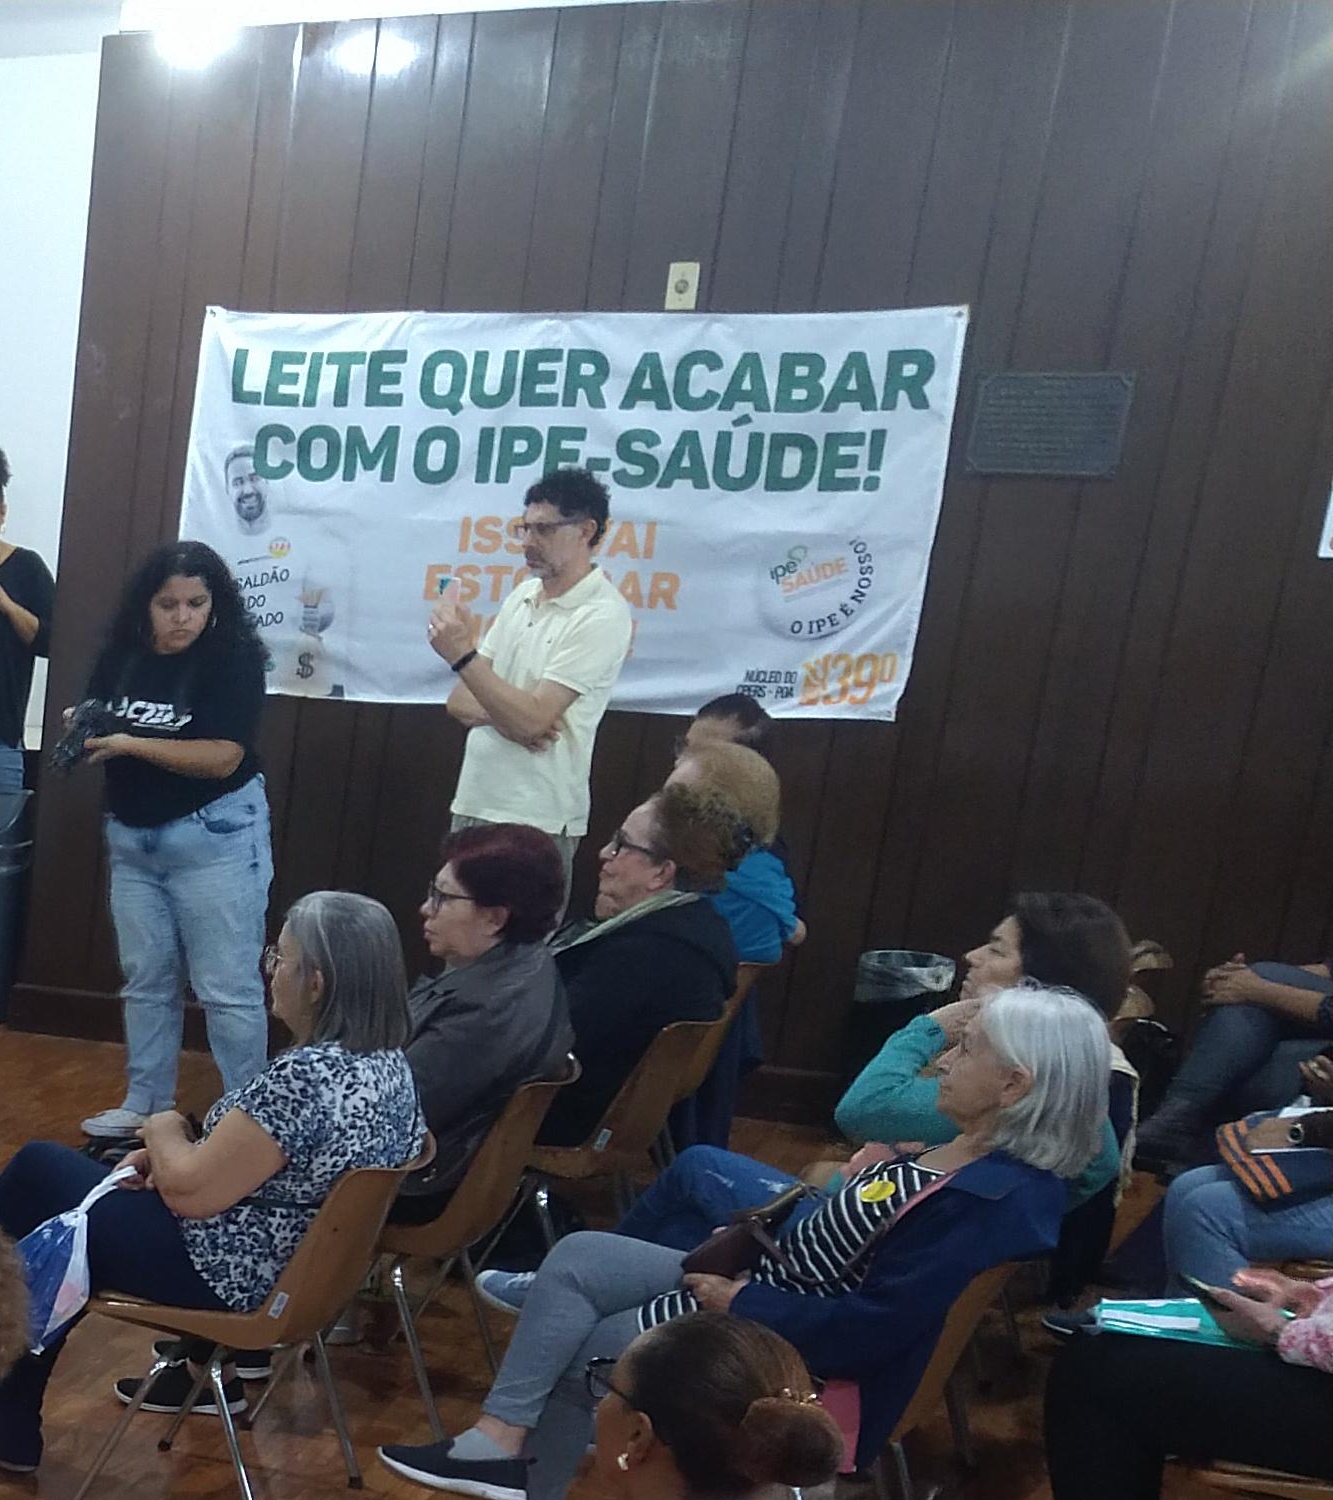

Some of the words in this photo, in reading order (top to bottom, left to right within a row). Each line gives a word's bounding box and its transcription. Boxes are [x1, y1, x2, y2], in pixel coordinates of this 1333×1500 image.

[232, 348, 408, 408] LEITE
[419, 348, 610, 416] QUER
[618, 349, 935, 413] ACABAR
[252, 423, 401, 482] COM
[413, 425, 461, 485] O
[474, 413, 887, 492] IPE-SAÚDE!
[458, 516, 526, 555] ISS
[595, 520, 658, 560] AI
[247, 595, 266, 609] DO
[423, 564, 681, 610] ESTAR
